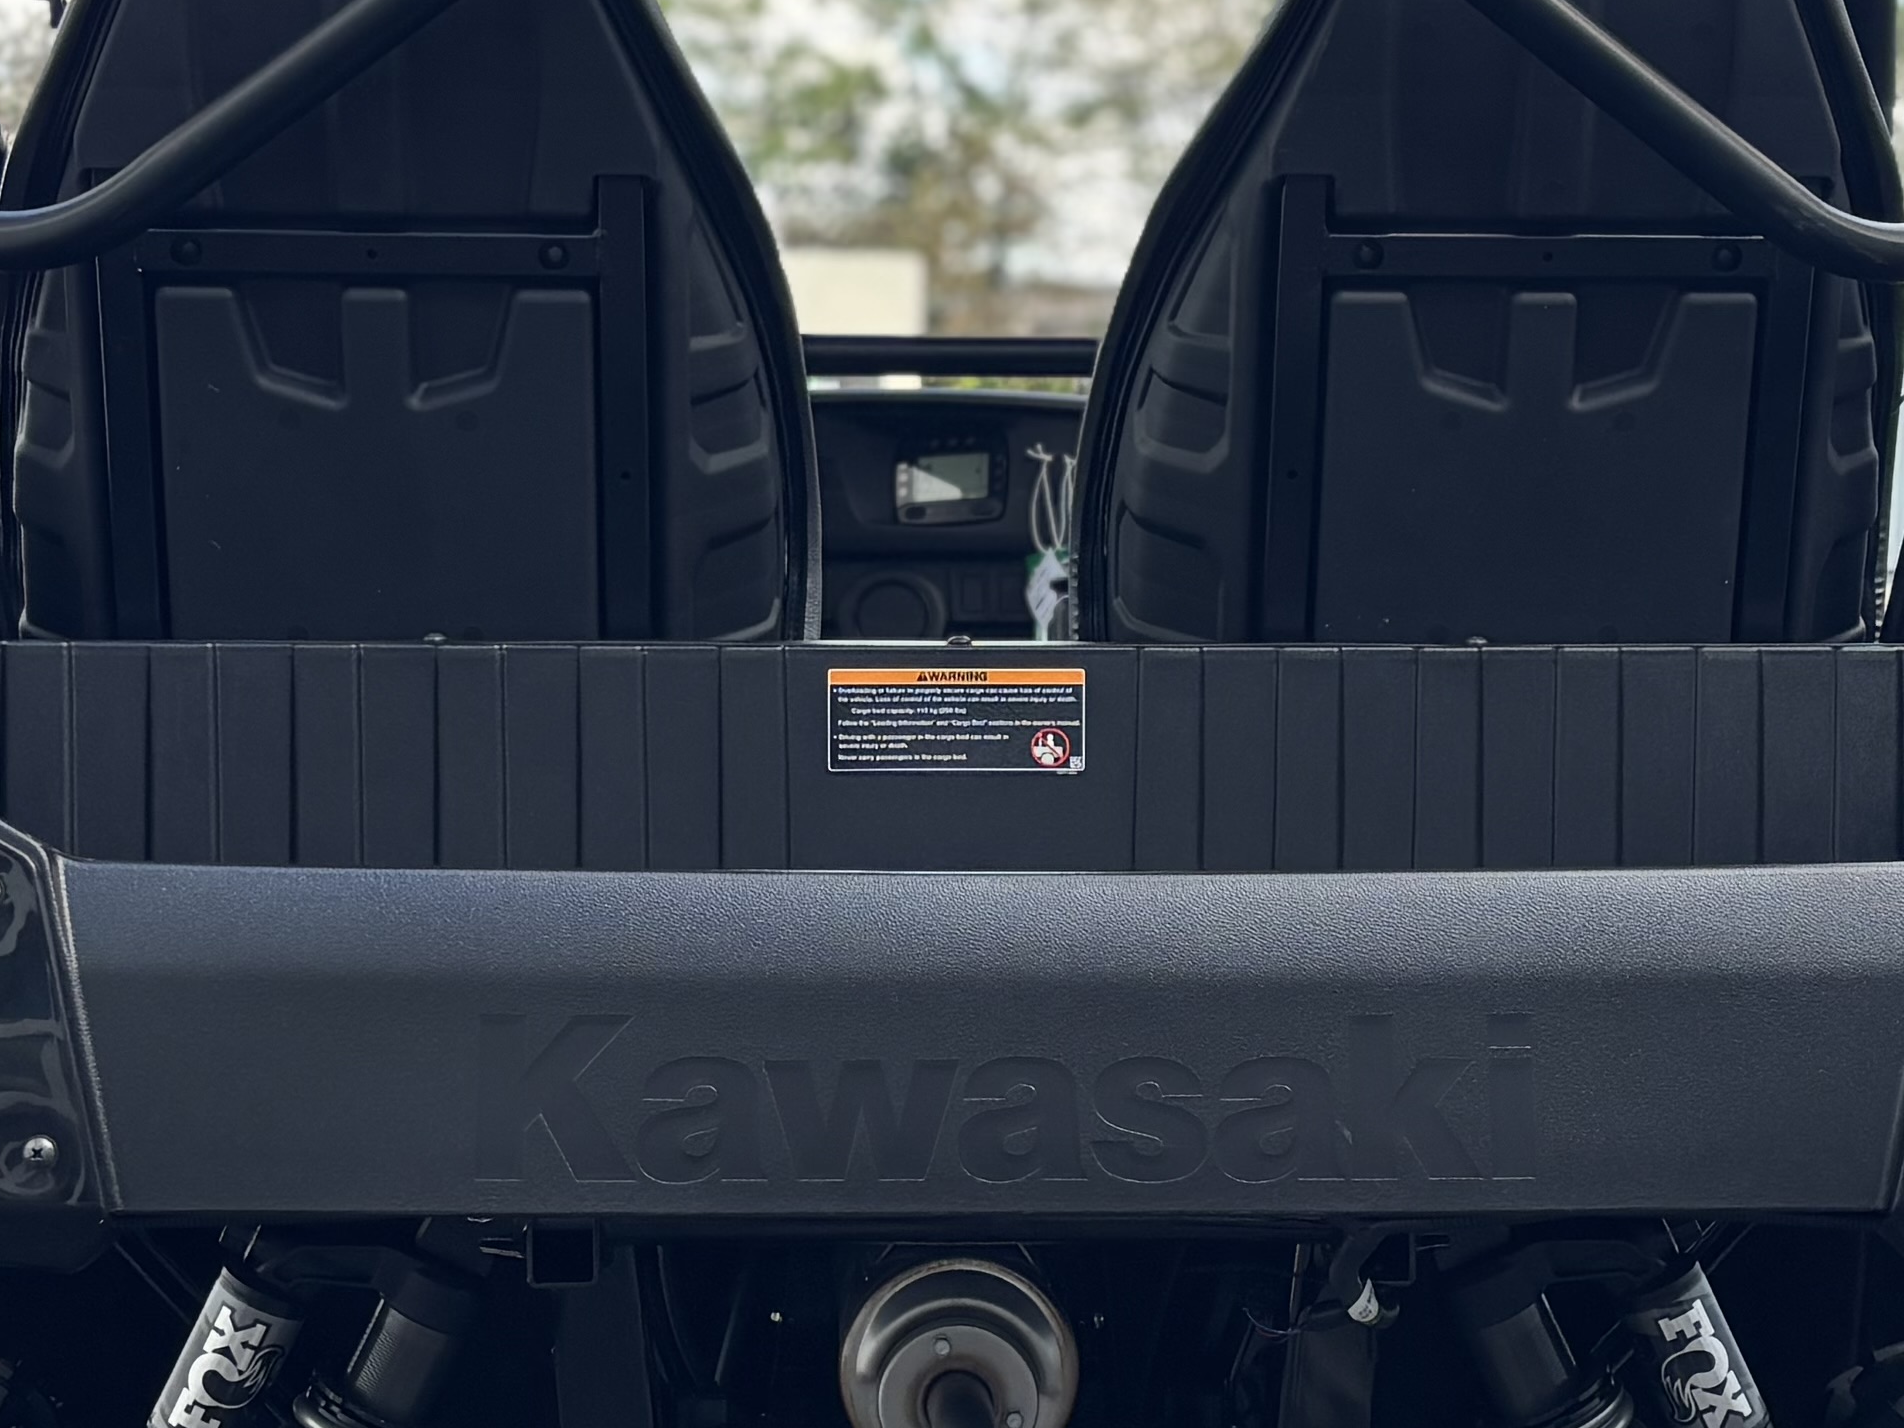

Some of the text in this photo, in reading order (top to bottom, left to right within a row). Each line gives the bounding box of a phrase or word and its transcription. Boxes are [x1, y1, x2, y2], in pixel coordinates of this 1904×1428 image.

[927, 671, 988, 682] WARNING
[851, 707, 871, 715] Cargo
[474, 1012, 1537, 1184] Kawasaki
